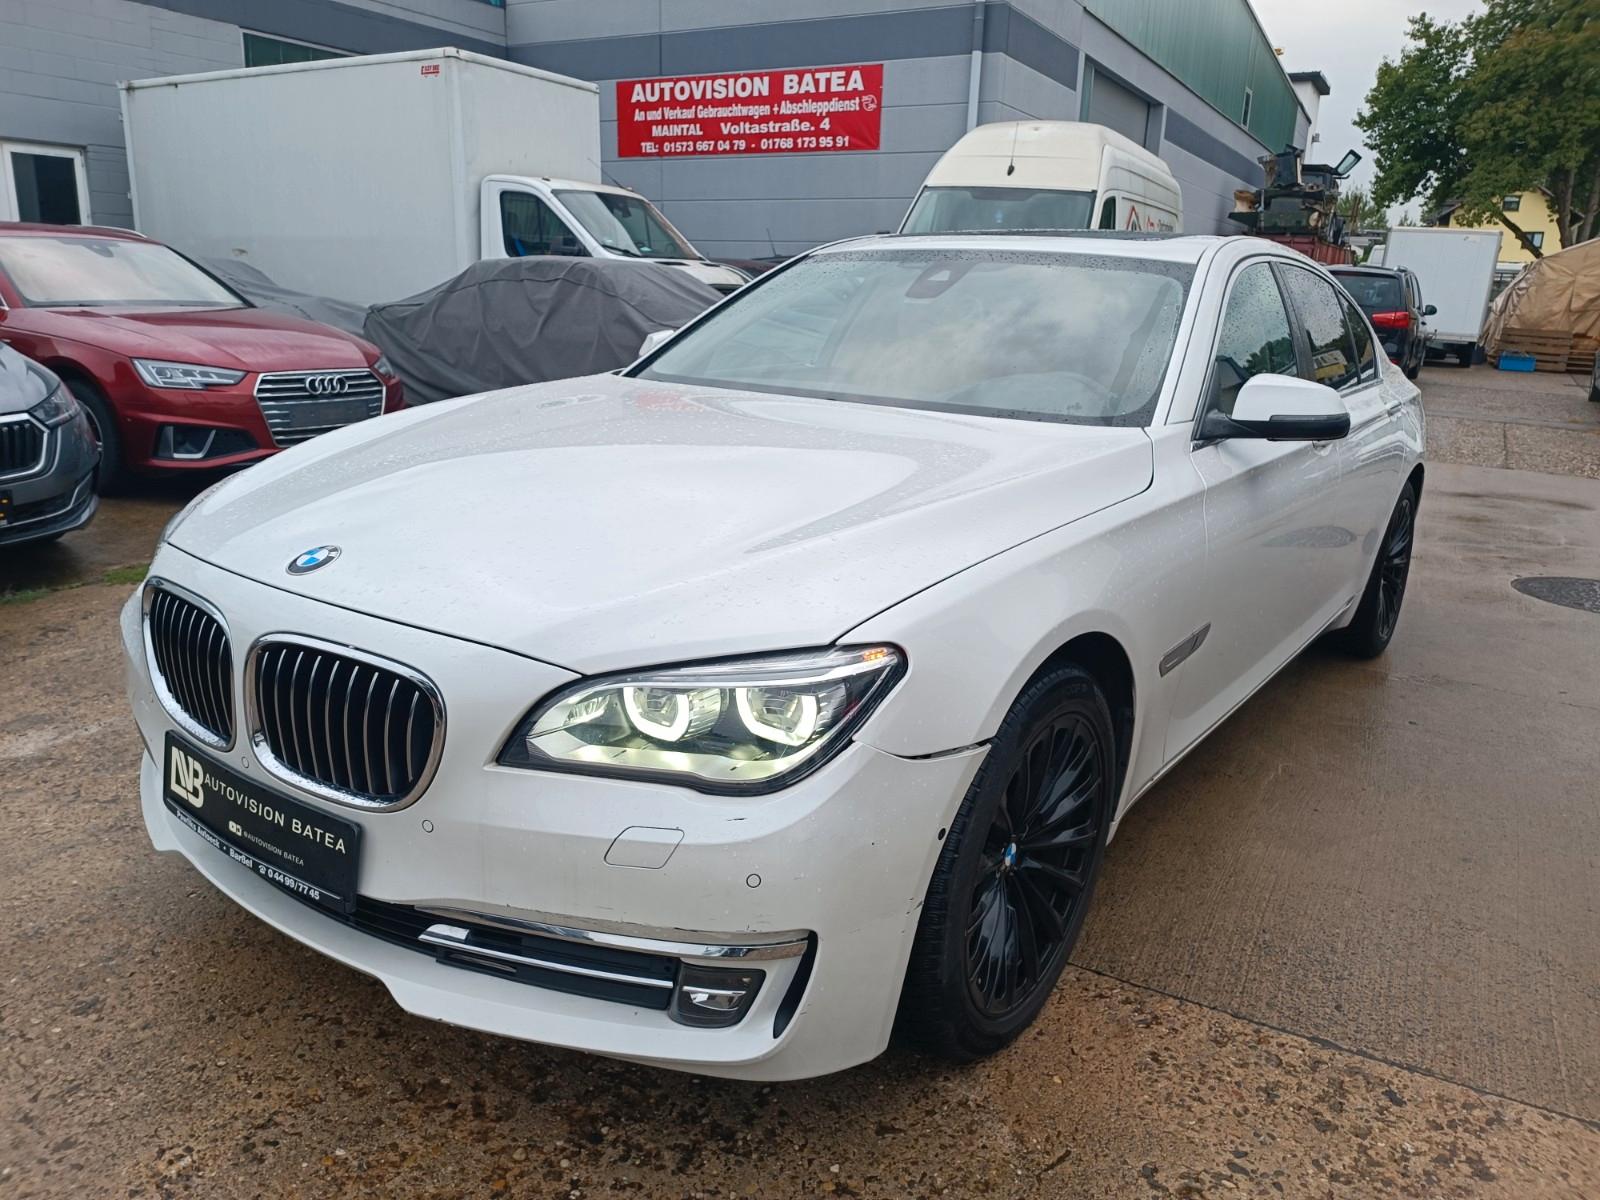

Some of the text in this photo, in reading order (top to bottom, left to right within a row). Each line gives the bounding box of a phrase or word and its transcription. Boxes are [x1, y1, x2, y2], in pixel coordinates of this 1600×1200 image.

[631, 70, 864, 103] AUTOVISION BATEA
[634, 109, 645, 121] An
[647, 107, 662, 120] und
[663, 105, 696, 120] Verkauf
[697, 103, 770, 119] Gebrauchtwagen
[652, 117, 831, 137] MAINTAL Voltastraße. 4
[641, 142, 659, 153] TEL:
[663, 141, 694, 152] 01573
[696, 140, 715, 152] 667
[717, 140, 730, 151] 04
[732, 139, 746, 150] 79
[760, 138, 793, 150] 01768
[797, 137, 816, 149] 173
[819, 136, 833, 148] 95
[836, 136, 849, 147] 91
[204, 773, 346, 854] AUTOVISION BATEA
[283, 851, 304, 867] BATEA
